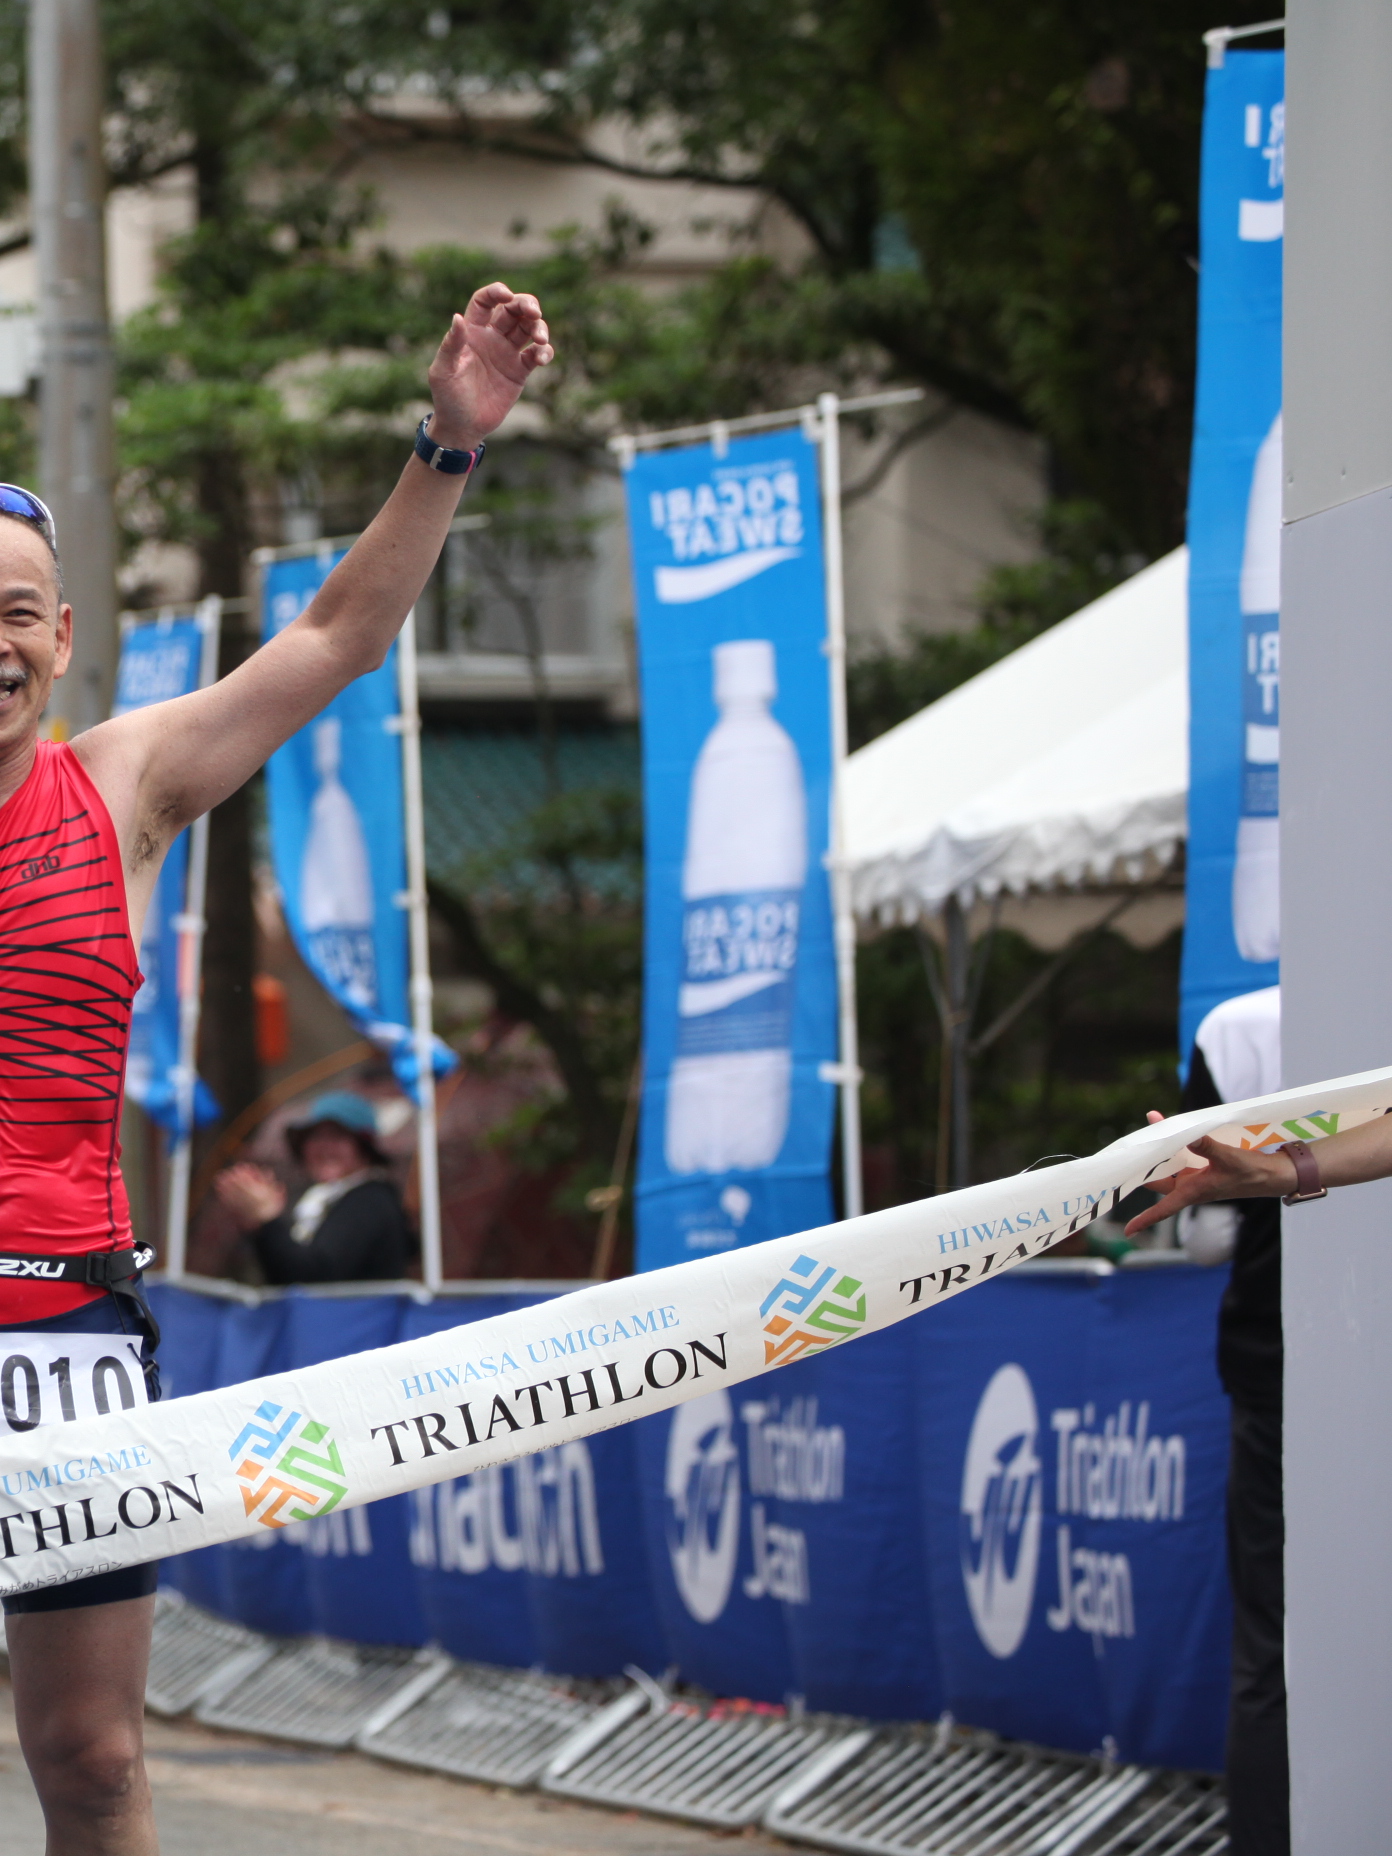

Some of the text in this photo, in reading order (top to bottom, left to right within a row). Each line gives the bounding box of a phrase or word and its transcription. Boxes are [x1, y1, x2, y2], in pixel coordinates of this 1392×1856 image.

[937, 1207, 1052, 1255] HIWASA
[370, 1332, 728, 1467] TRIATHLON
[399, 1305, 680, 1400] HIWASA UMIGAME
[1, 1444, 152, 1496] UMIGAME
[1051, 1401, 1186, 1521] Triathlon
